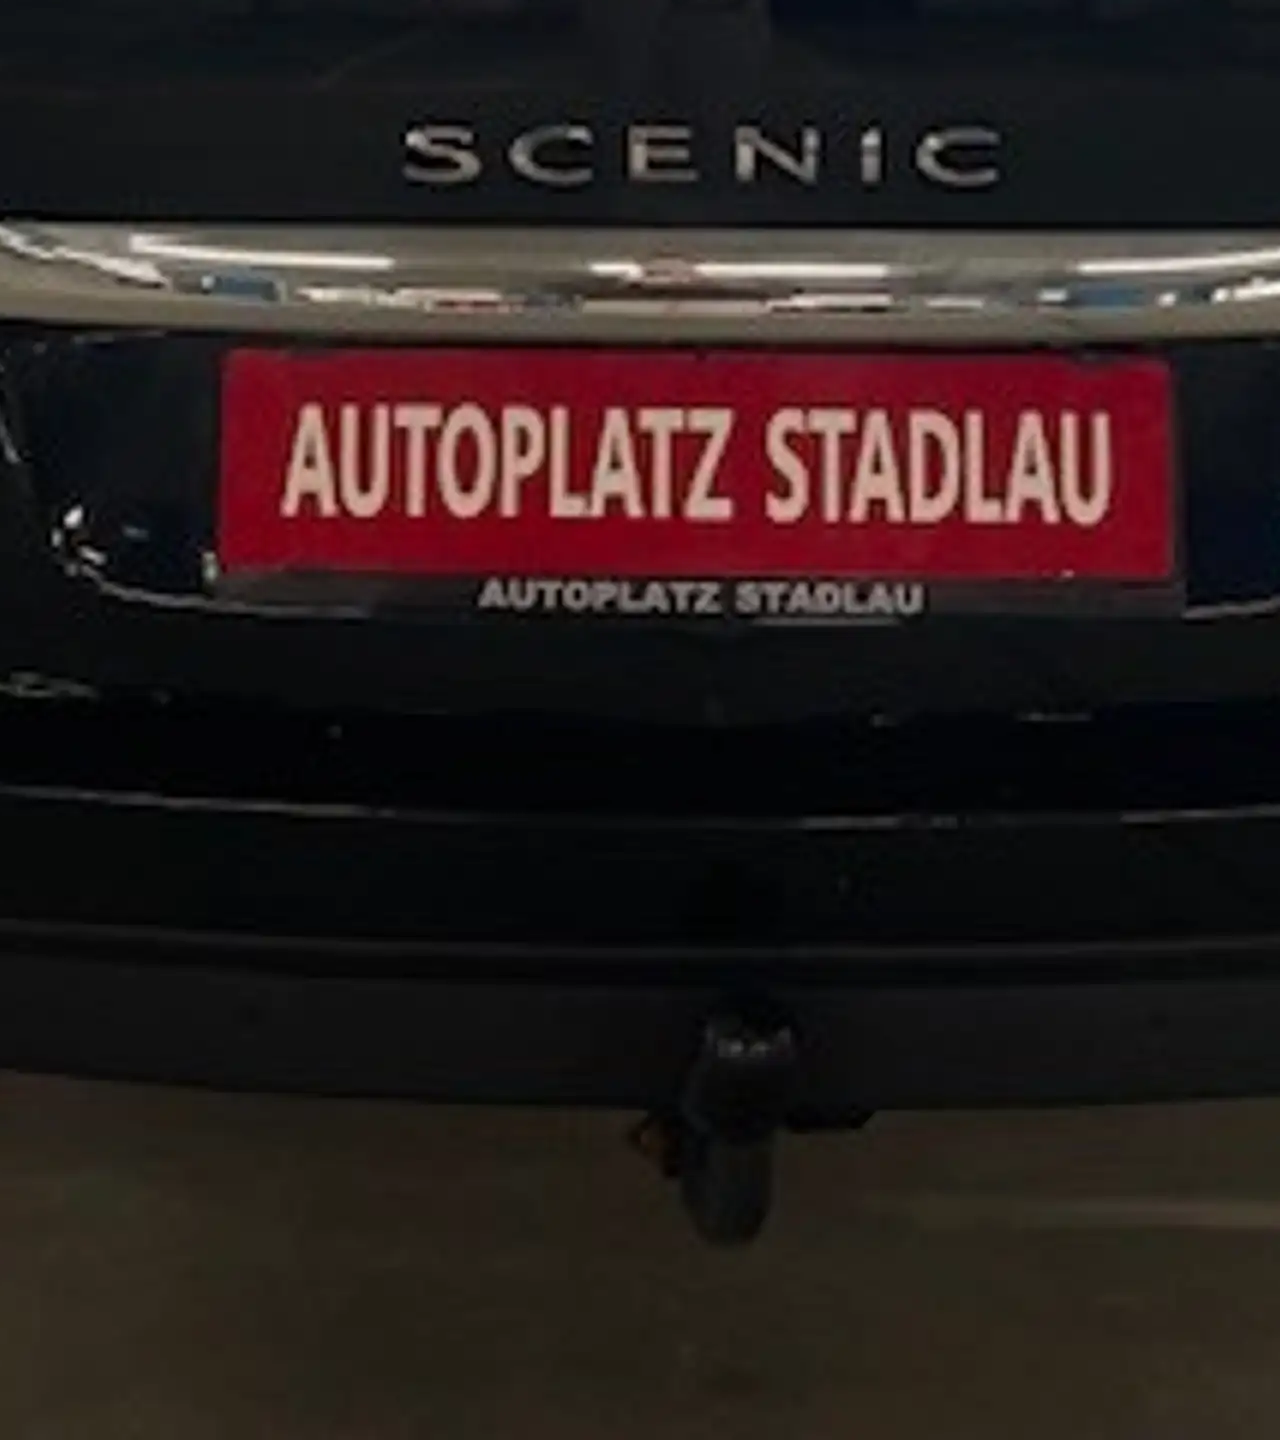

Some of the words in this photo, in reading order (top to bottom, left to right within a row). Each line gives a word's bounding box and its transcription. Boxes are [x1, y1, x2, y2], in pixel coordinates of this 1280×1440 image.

[403, 126, 1002, 186] SCENIC
[282, 406, 736, 520] AUTOPLATZ
[765, 410, 1111, 524] STADLAU
[478, 579, 721, 614] AUTOPLATZ
[734, 581, 924, 616] STADLAU
